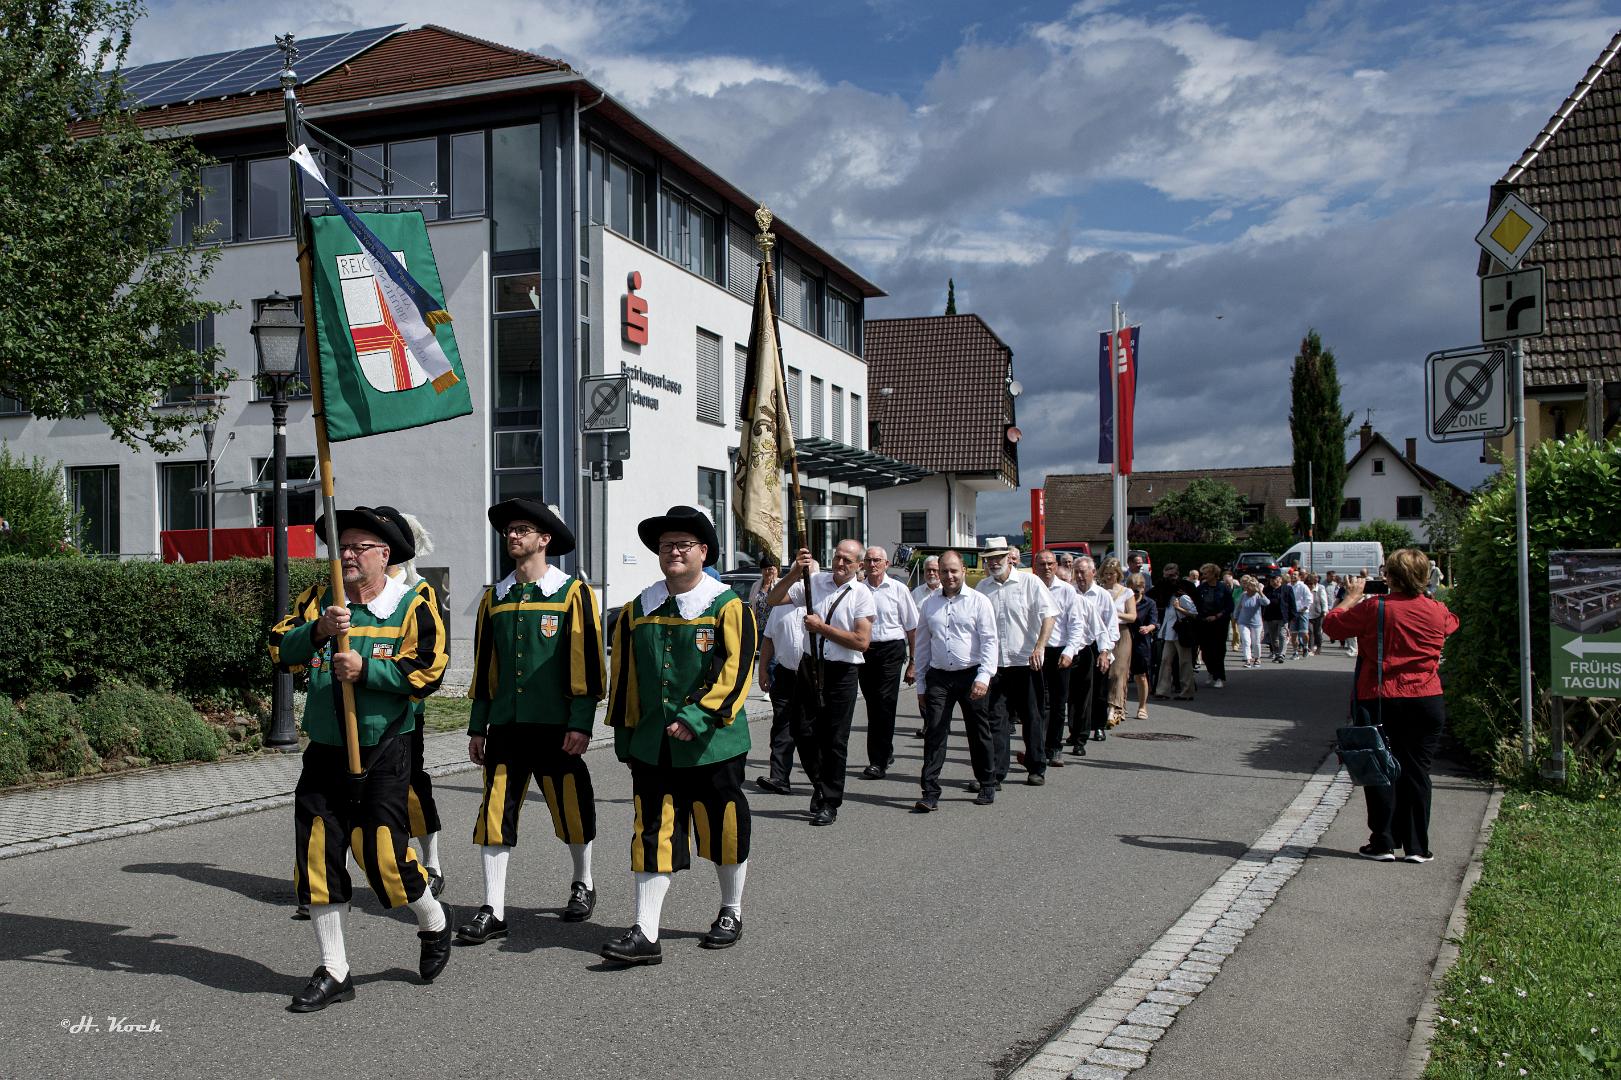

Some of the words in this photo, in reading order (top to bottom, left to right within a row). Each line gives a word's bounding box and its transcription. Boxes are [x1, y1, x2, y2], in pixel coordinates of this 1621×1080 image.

[621, 361, 682, 395] Bezirkssparkasse
[594, 416, 617, 427] ZONE
[1450, 412, 1488, 428] ZONE
[1561, 676, 1621, 689] TAGUN
